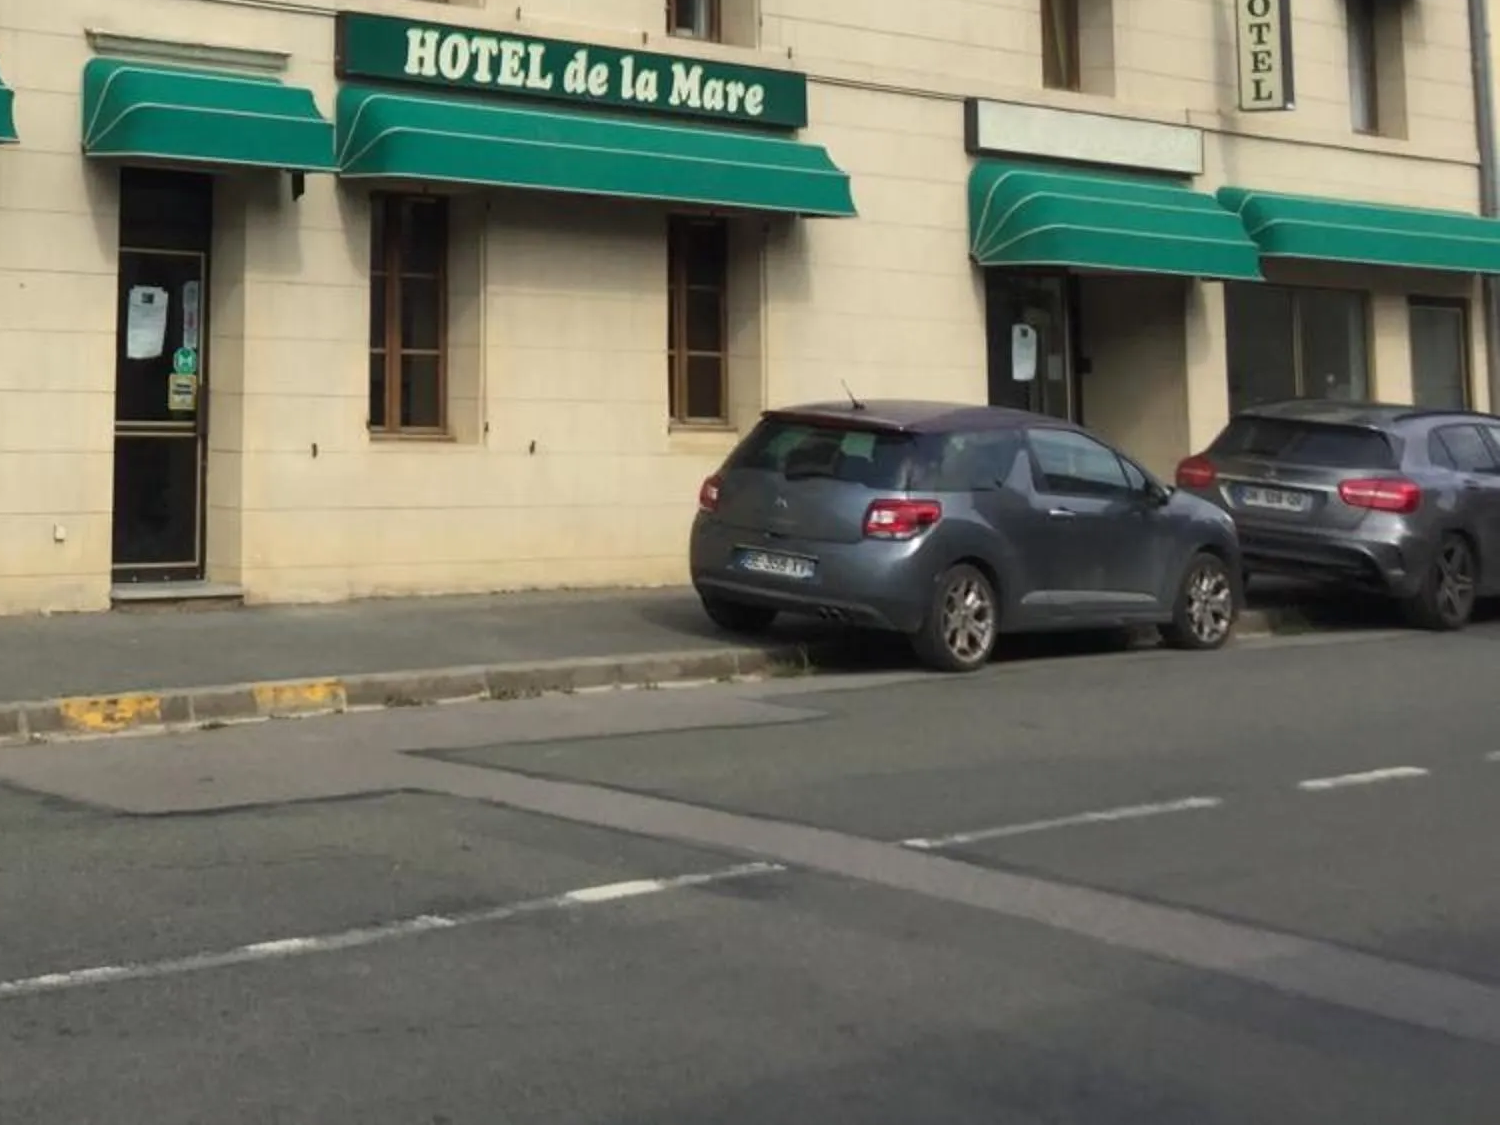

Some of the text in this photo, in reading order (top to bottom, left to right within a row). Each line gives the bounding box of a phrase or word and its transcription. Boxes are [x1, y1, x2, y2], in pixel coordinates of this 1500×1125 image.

[404, 27, 765, 117] HOTEL de la Mare
